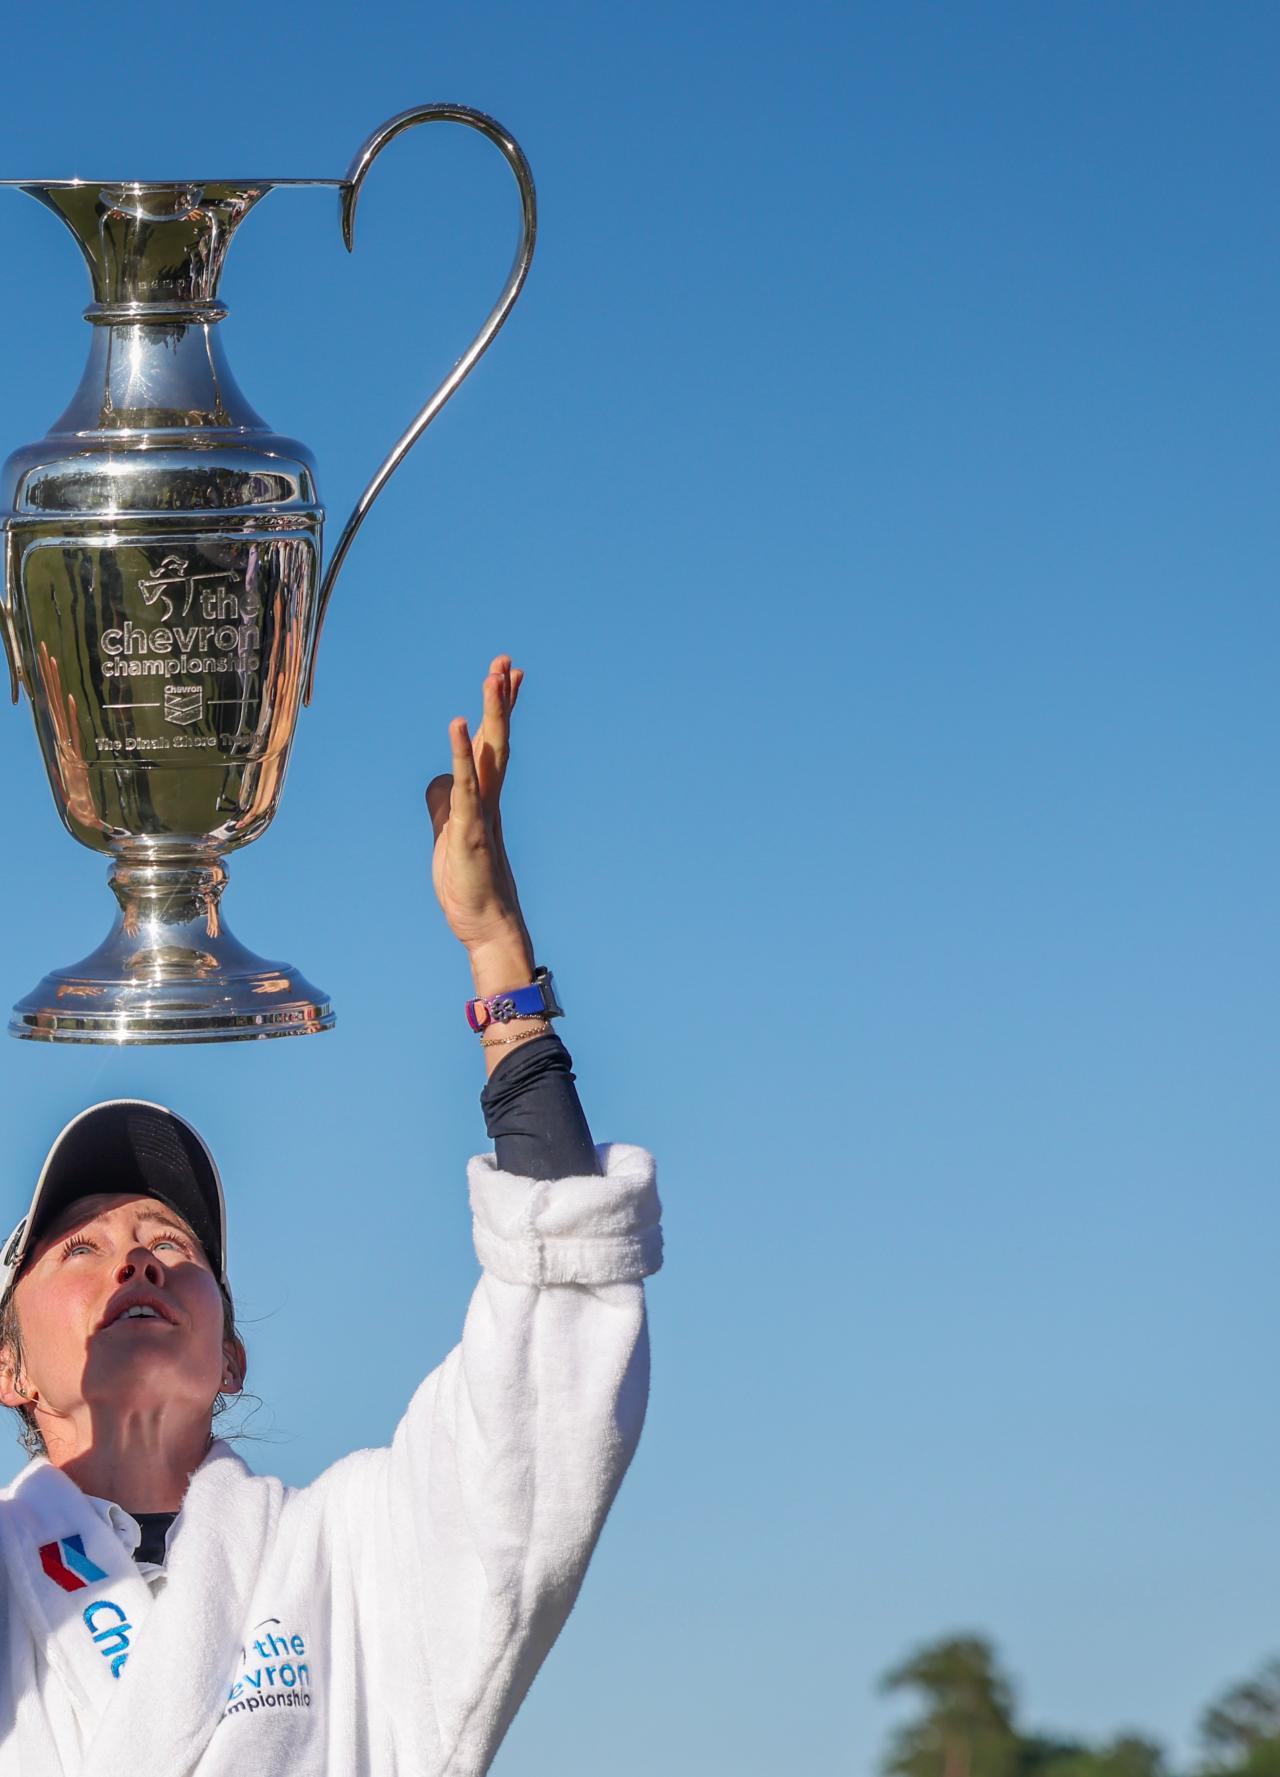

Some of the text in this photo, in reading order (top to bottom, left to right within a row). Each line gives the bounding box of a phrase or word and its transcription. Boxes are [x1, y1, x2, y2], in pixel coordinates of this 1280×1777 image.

[200, 587, 260, 619] the
[101, 621, 260, 655] chevron
[101, 653, 259, 678] championship
[164, 685, 202, 694] Chevron
[95, 737, 122, 750] The
[125, 736, 170, 750] Dinah
[172, 736, 217, 748] Shore
[253, 1633, 305, 1658] the
[221, 1689, 311, 1719] mpionship
